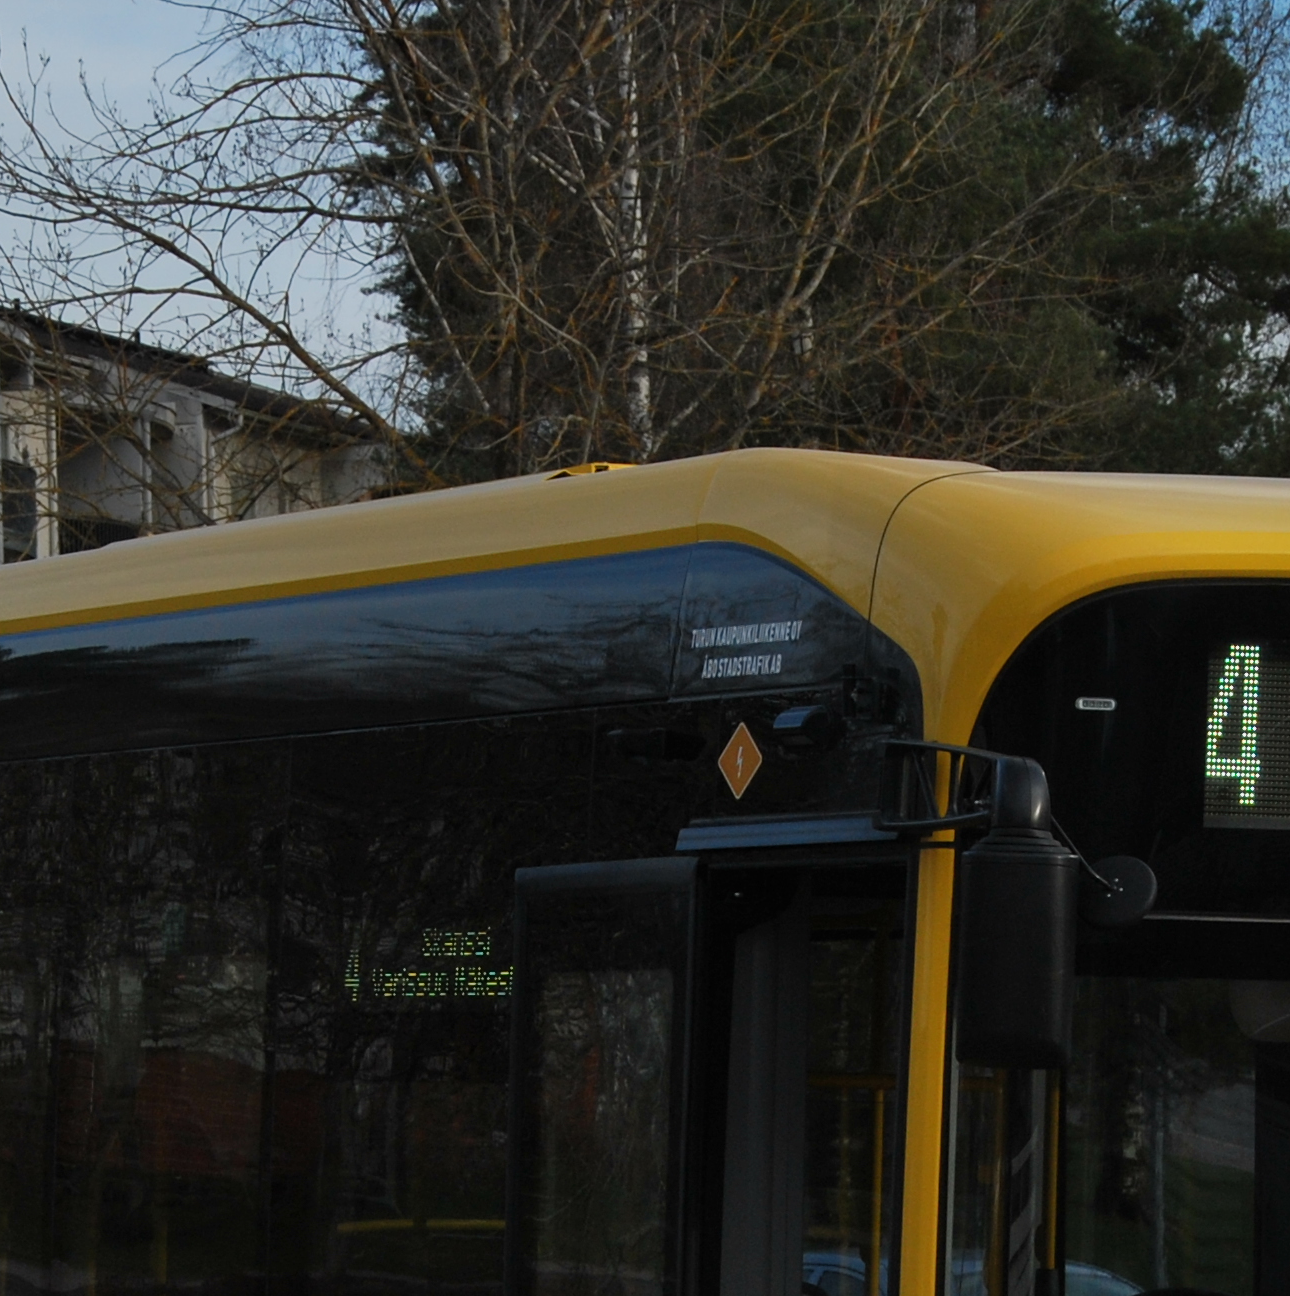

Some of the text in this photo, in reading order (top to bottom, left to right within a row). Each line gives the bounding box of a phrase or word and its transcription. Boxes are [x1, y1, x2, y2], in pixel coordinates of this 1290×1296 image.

[691, 620, 803, 648] TURUN KAUPUNKILIIKENNE OY
[701, 653, 782, 680] ÅBO STADSTRAFIK AB
[1205, 645, 1260, 807] 4
[422, 926, 491, 956] Skanssi
[344, 949, 360, 1002] 4
[372, 967, 449, 997] Varissuo
